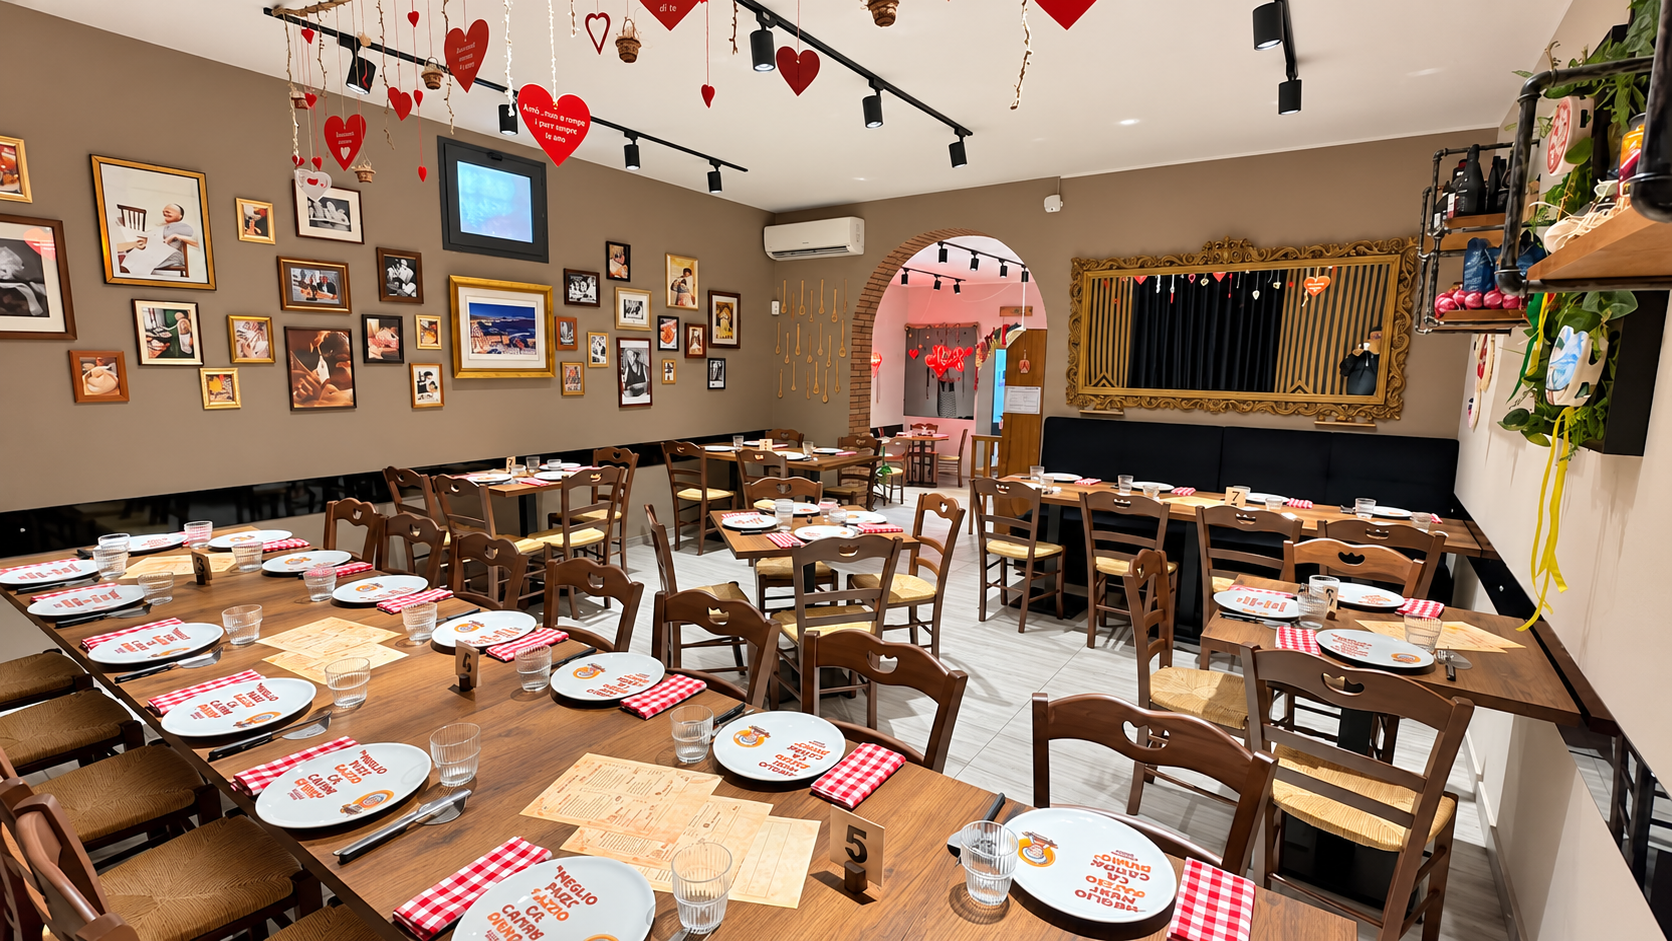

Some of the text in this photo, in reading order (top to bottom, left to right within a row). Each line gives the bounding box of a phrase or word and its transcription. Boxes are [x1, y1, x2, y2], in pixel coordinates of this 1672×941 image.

[659, 3, 677, 12] di te
[1232, 490, 1240, 502] 7
[196, 556, 205, 573] 3
[845, 824, 868, 864] 5
